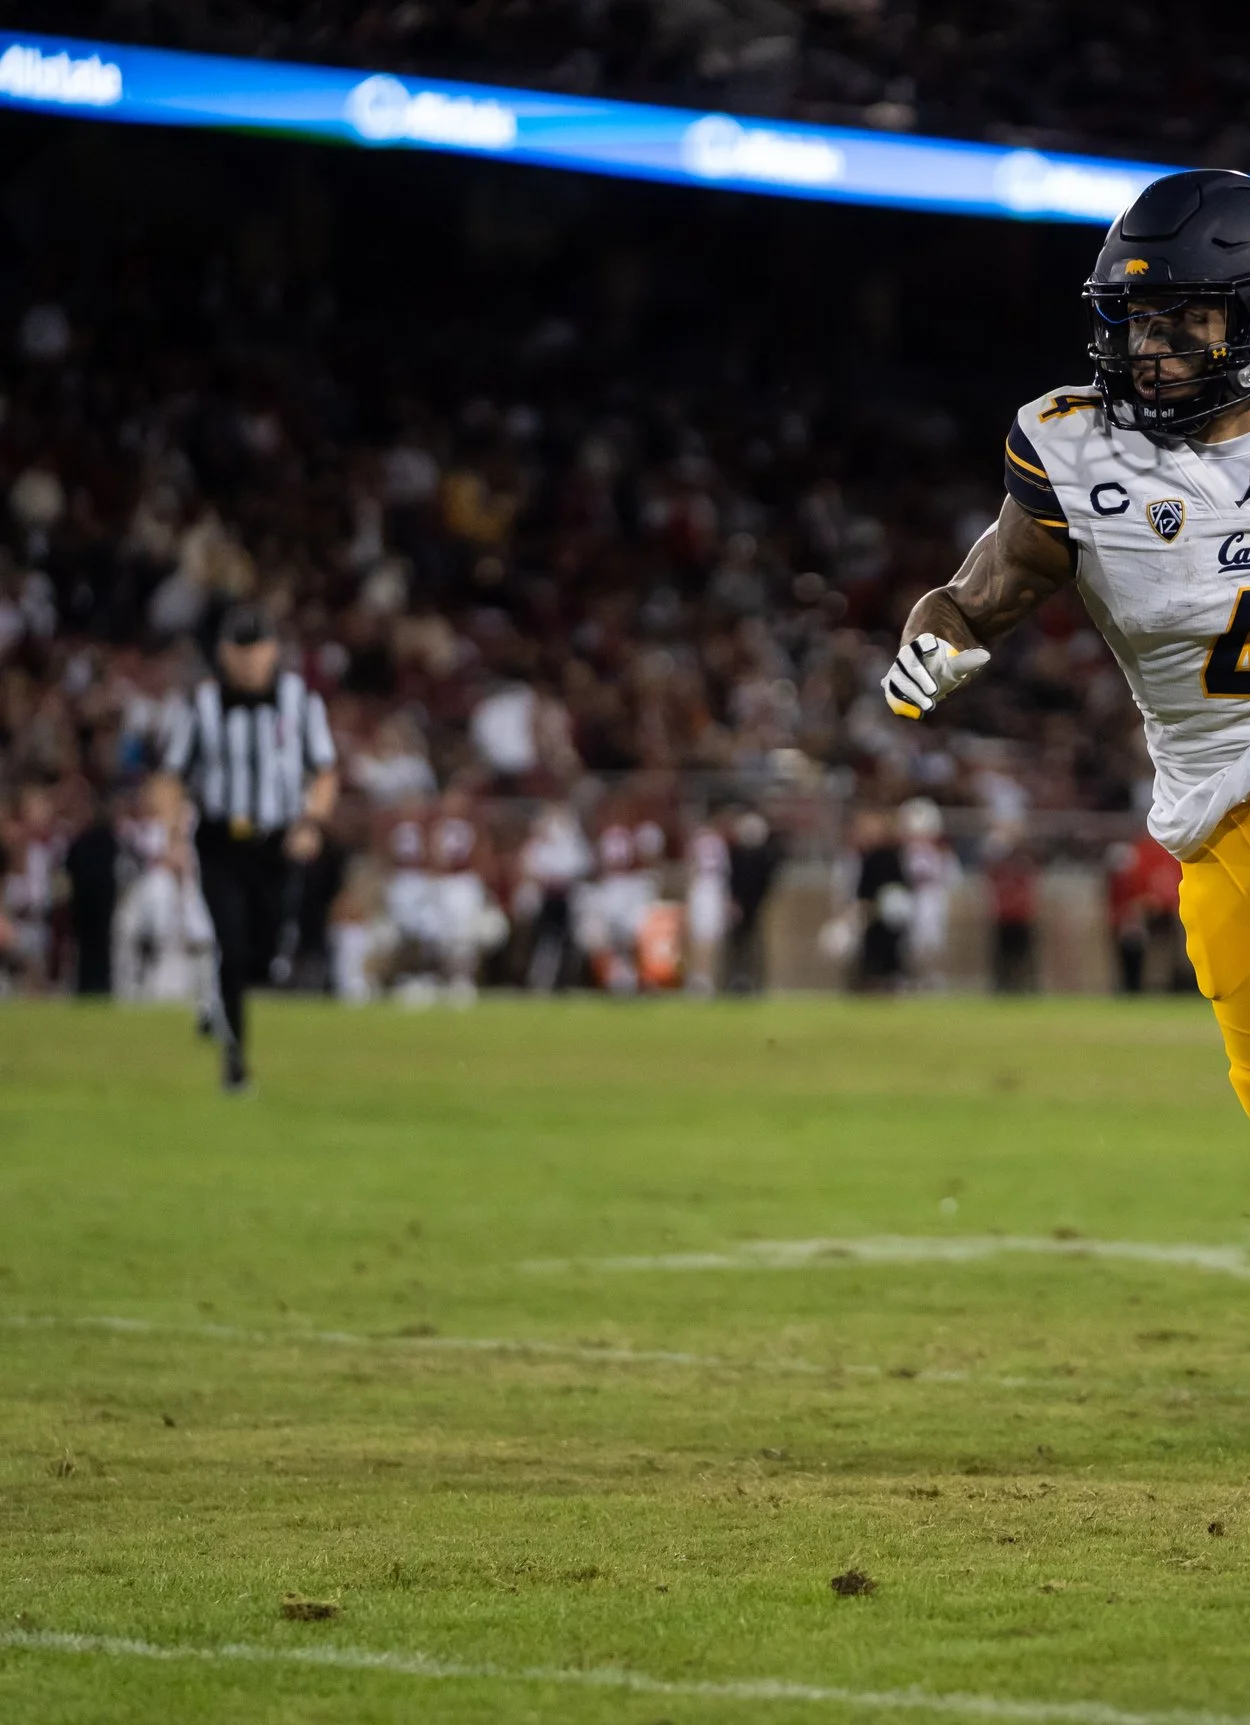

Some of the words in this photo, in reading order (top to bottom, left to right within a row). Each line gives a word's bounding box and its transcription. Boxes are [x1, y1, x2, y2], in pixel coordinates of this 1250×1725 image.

[1039, 394, 1104, 423] 4
[1143, 407, 1175, 418] Ridell
[1090, 482, 1130, 516] C
[1150, 501, 1183, 527] PAC
[1159, 517, 1178, 535] 12
